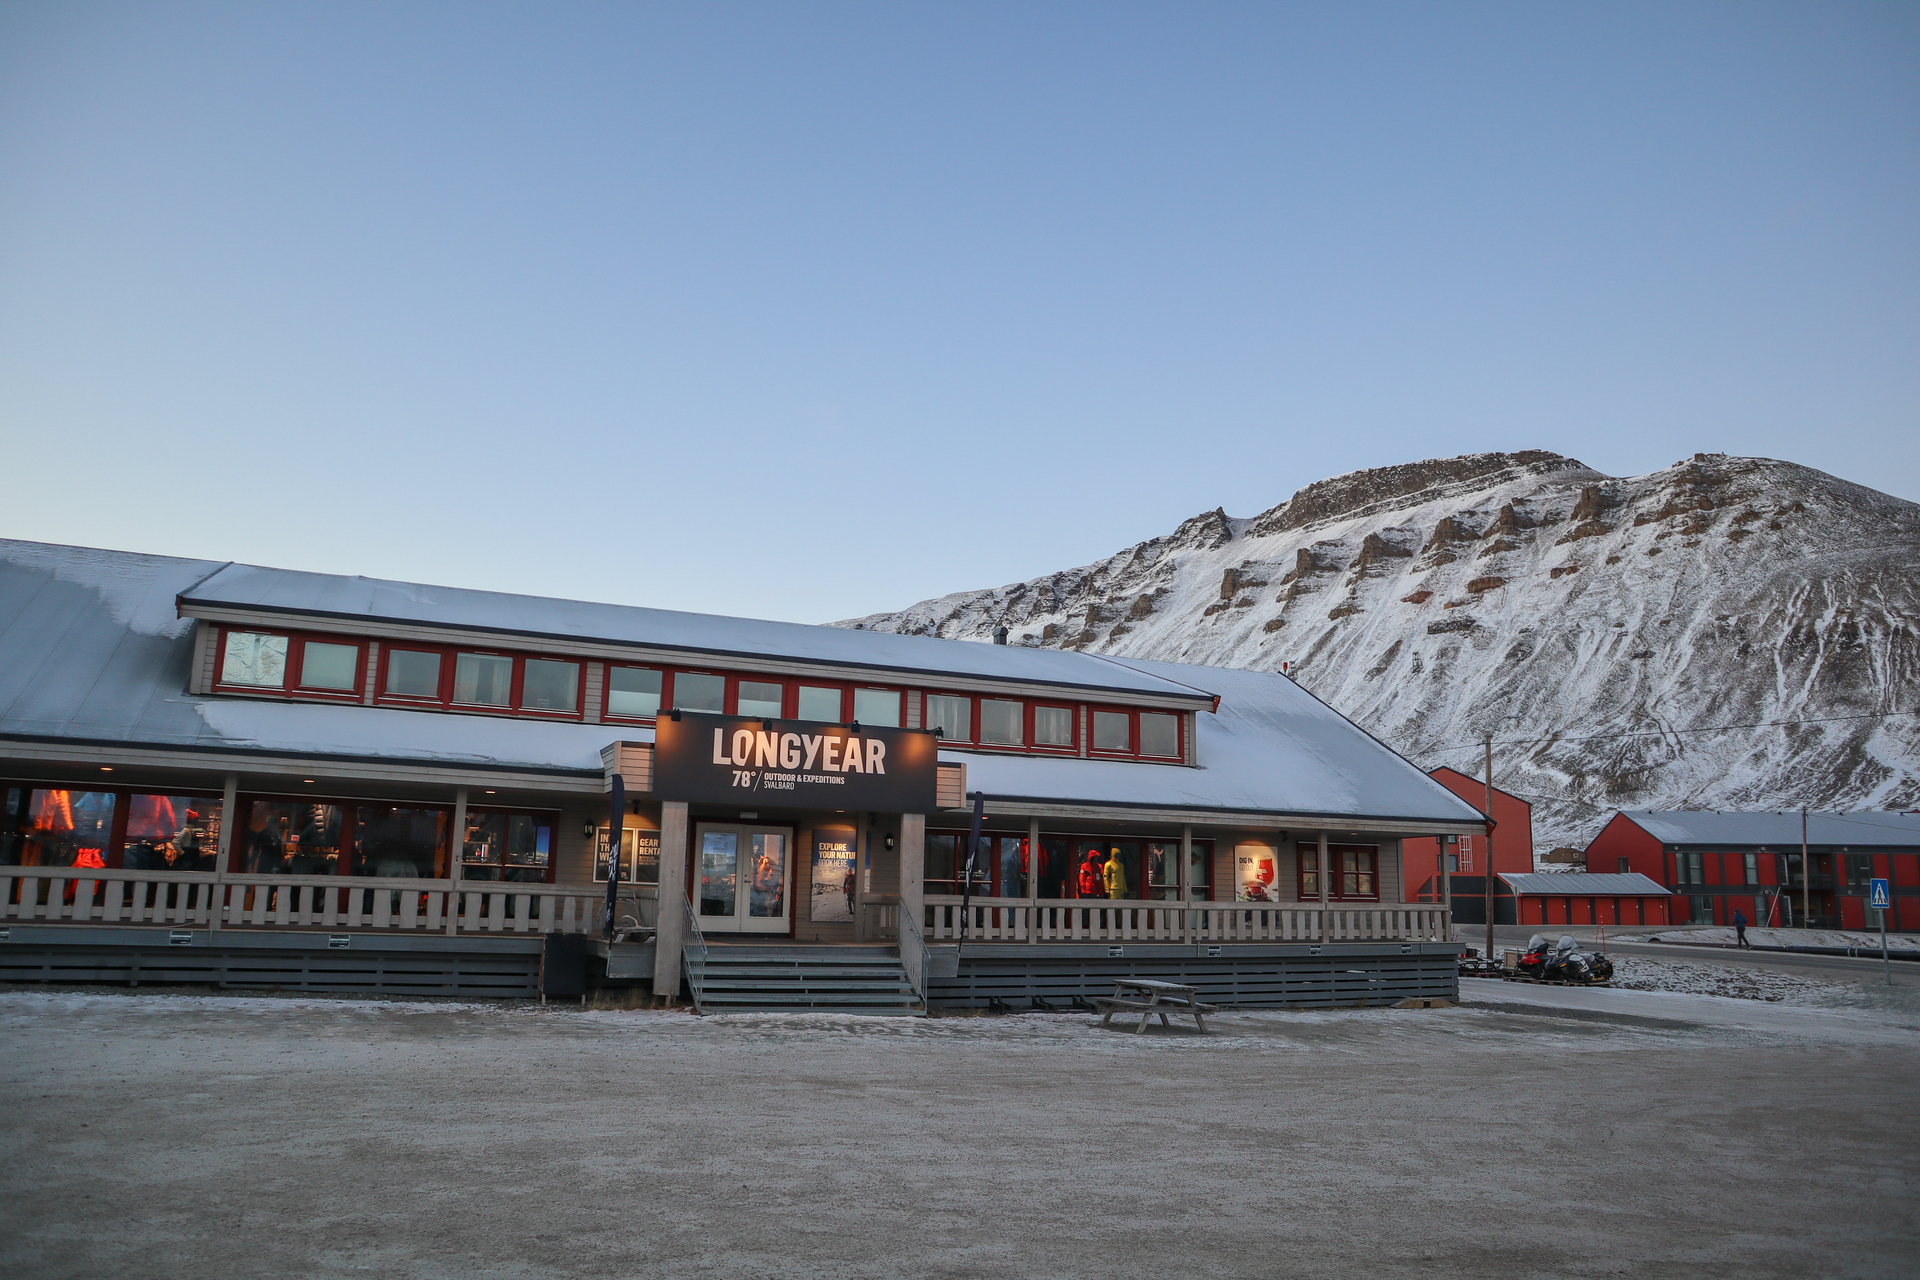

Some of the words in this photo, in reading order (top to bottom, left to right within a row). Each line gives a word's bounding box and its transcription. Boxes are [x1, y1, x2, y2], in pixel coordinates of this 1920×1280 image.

[713, 727, 886, 774] LONGYEAR
[764, 773, 795, 782] OUTDOOR
[803, 775, 845, 785] EXPEDITIONS
[764, 781, 795, 790] SVALBARD
[639, 838, 658, 846] GEAR
[819, 842, 847, 851] EXPLORE
[819, 851, 835, 859] YOUR
